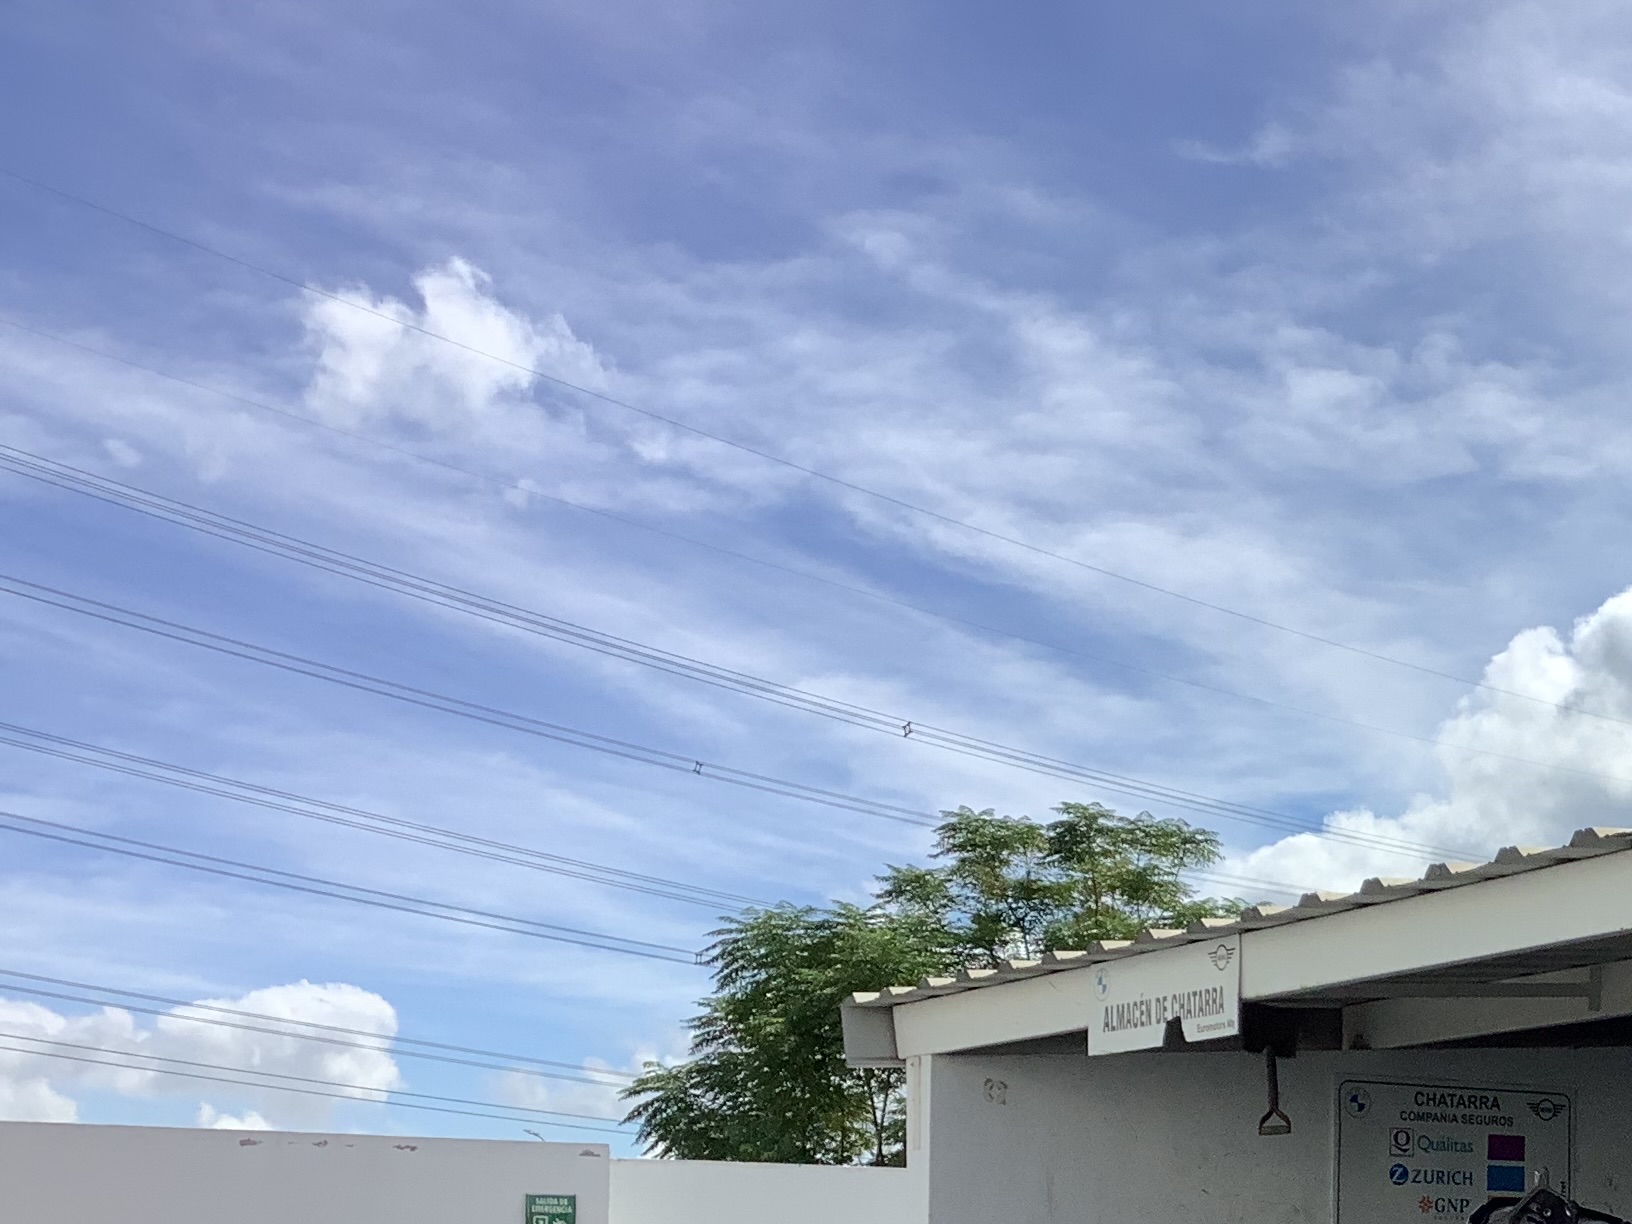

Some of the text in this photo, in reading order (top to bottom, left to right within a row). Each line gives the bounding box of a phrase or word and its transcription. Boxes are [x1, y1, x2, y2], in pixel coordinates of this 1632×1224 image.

[1102, 985, 1225, 1033] ALMACÉN DE CHATARRA
[1414, 1091, 1500, 1110] CHATARRA
[1461, 1113, 1514, 1127] SEGUROS
[1411, 1169, 1473, 1186] ZURICH
[1434, 1197, 1470, 1213] GNP
